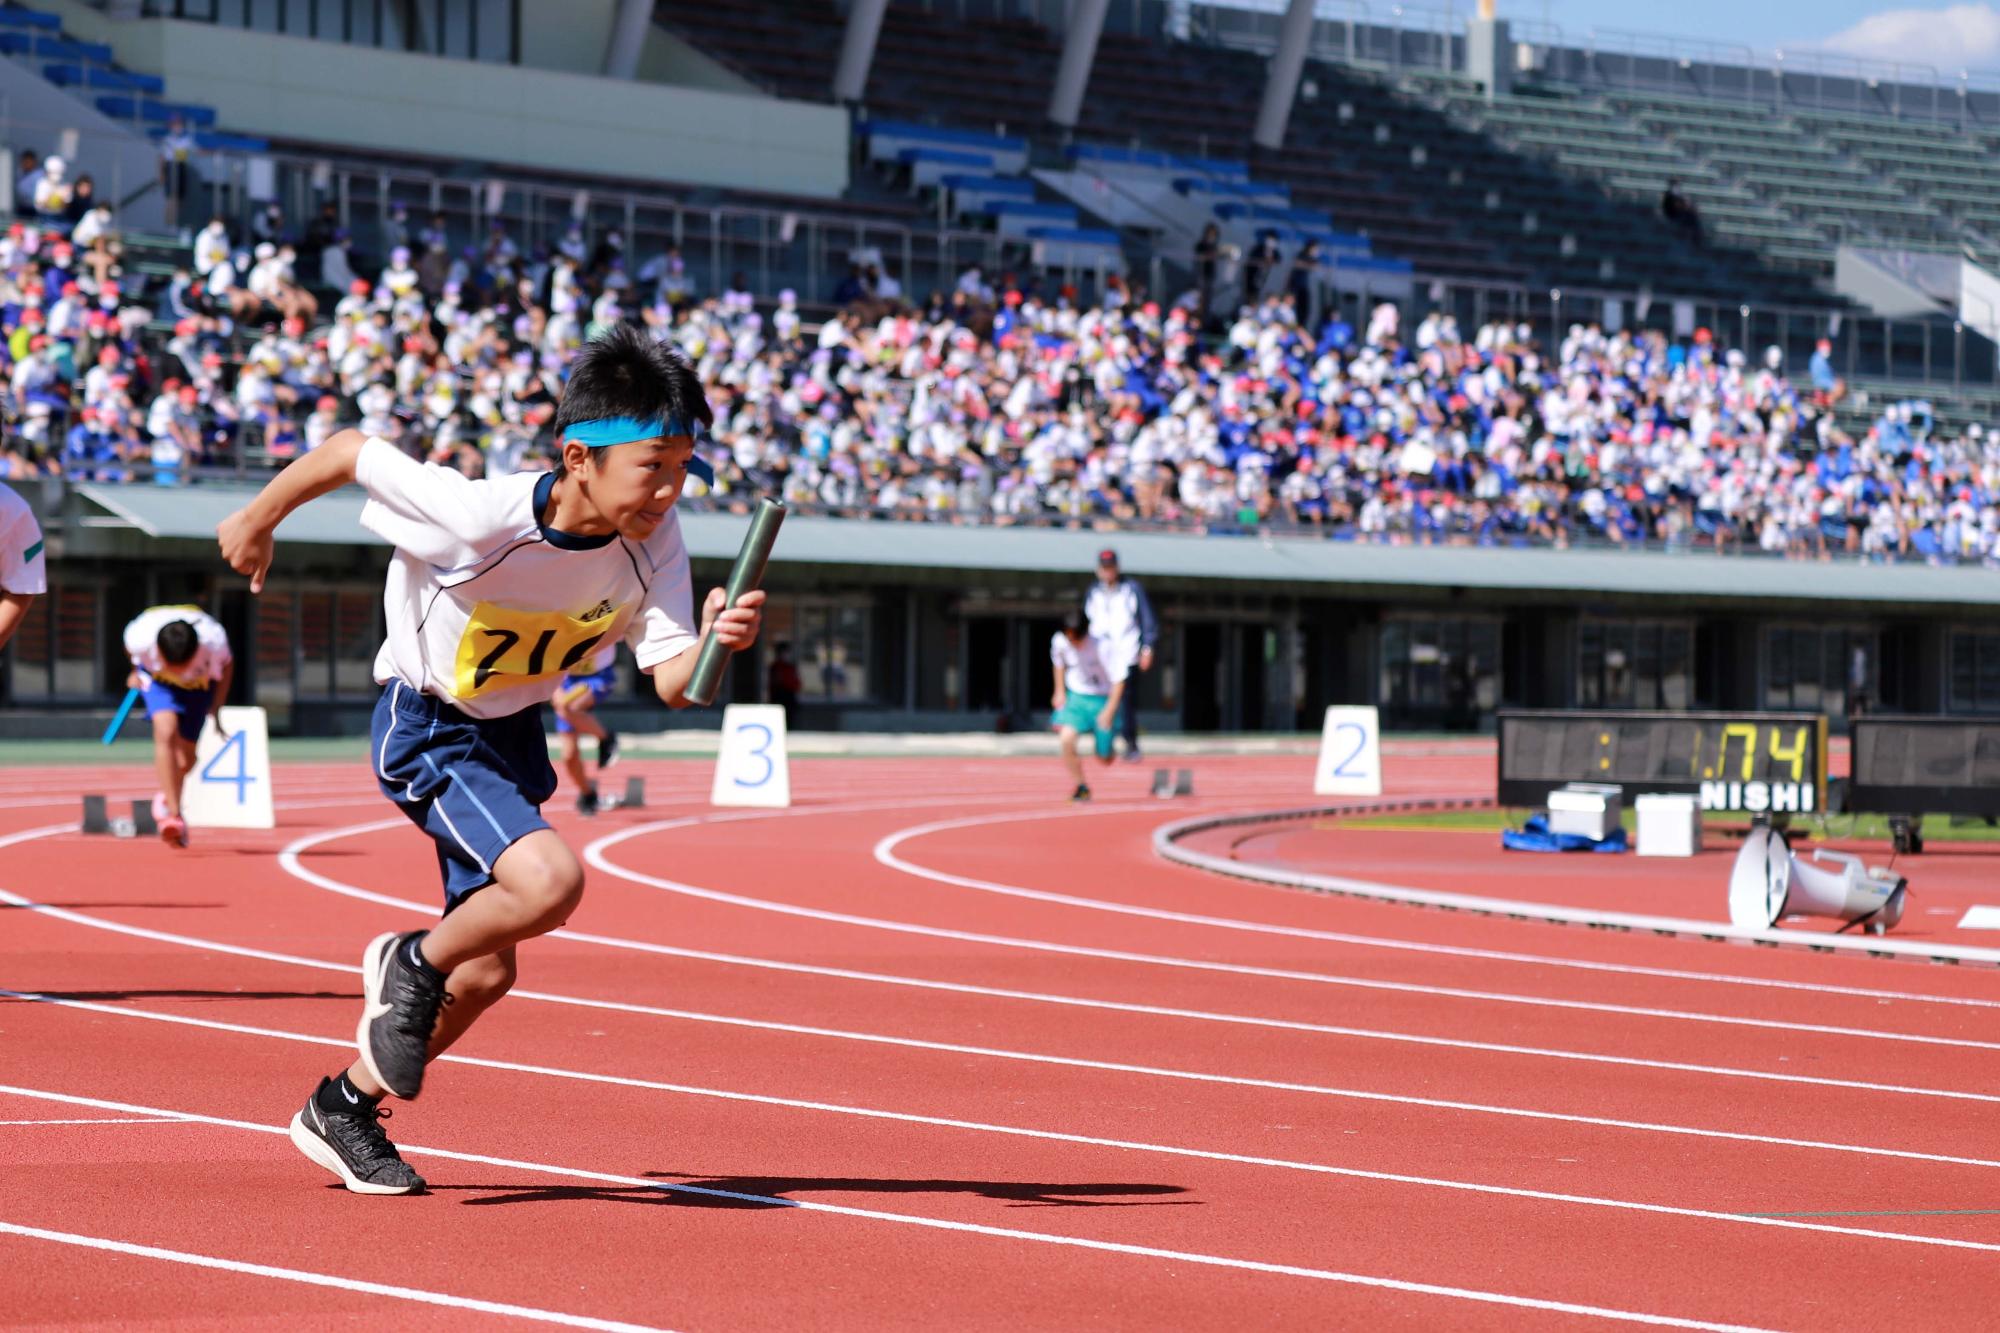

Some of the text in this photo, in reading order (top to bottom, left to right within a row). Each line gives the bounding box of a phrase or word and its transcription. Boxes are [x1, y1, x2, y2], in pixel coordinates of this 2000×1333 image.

[201, 729, 258, 806] 4
[733, 722, 774, 788] 3
[1332, 722, 1367, 777] 2
[1700, 780, 1814, 812] NISHI
